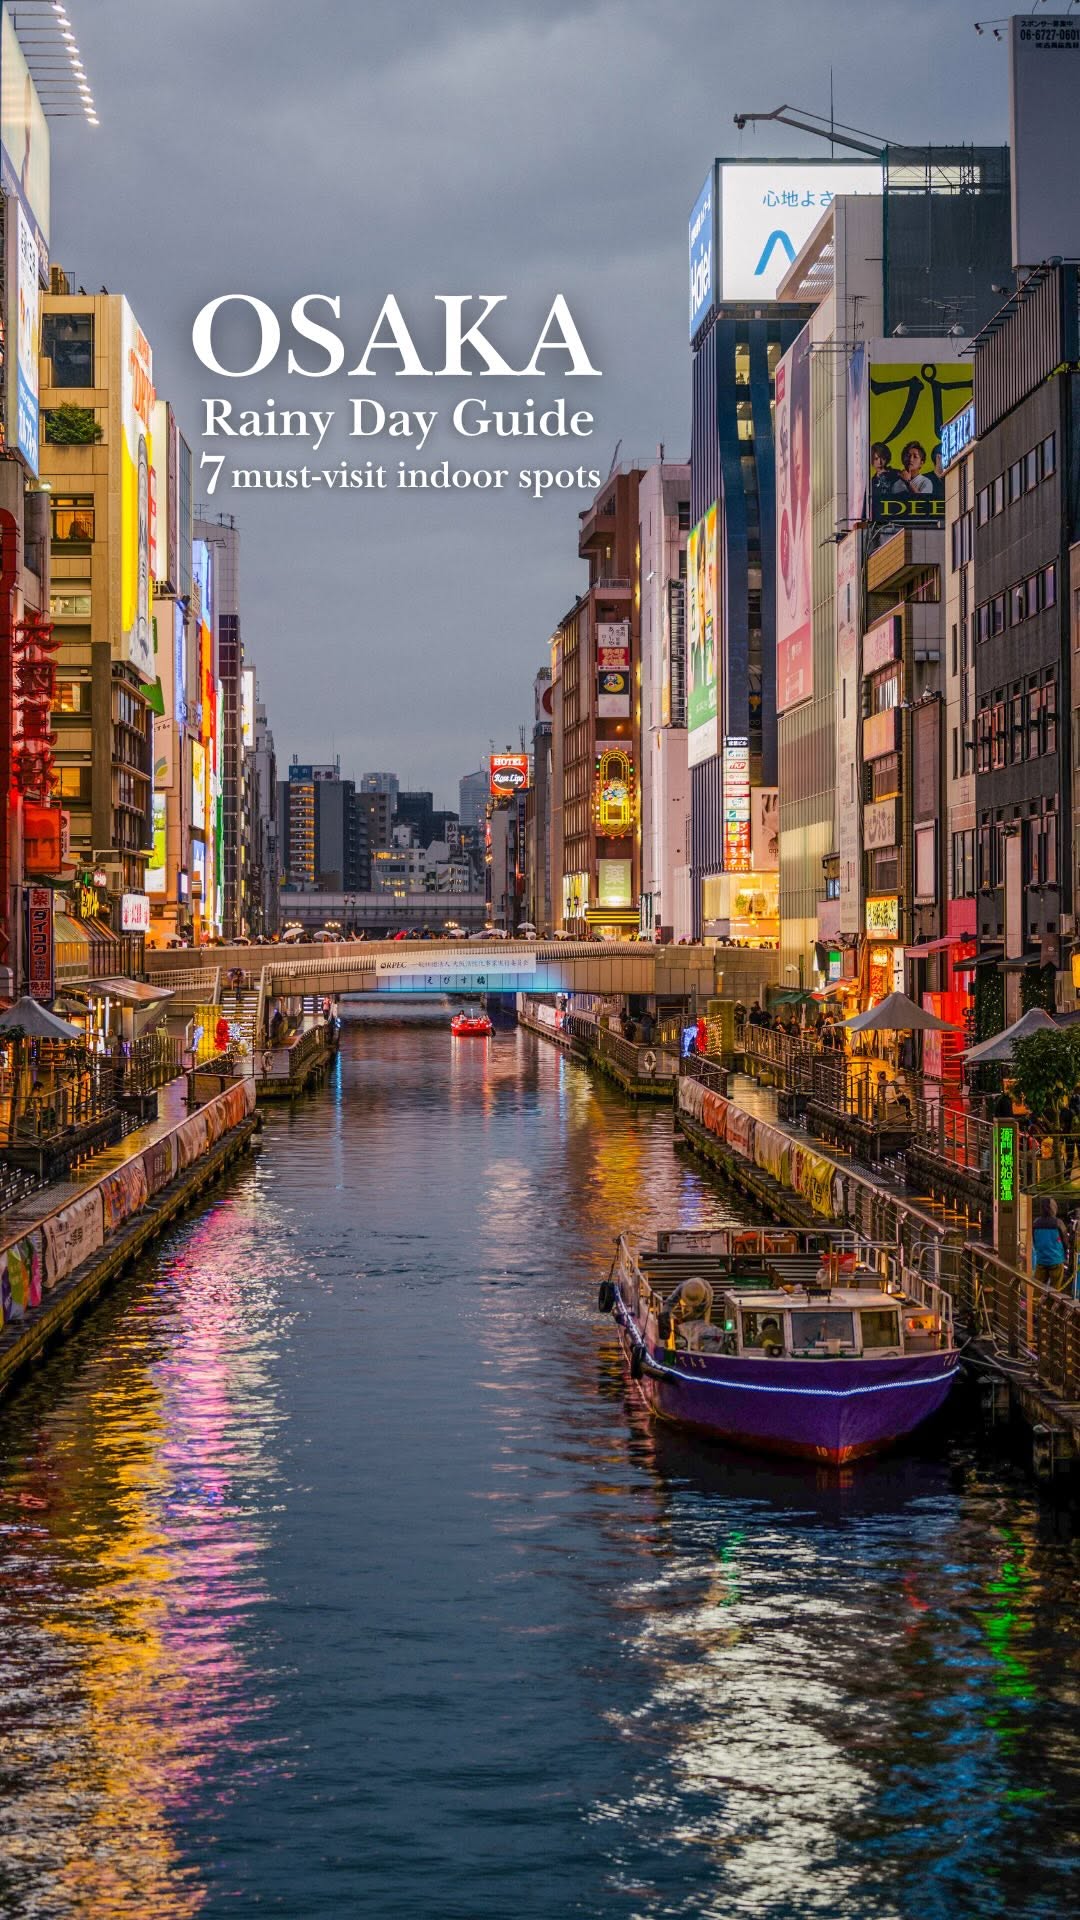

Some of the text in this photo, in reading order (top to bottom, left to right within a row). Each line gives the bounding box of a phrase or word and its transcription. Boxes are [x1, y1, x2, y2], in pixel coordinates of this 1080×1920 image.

[1020, 29, 1080, 40] 06-6727-0601
[494, 758, 524, 766] HOTEL
[494, 773, 524, 785] Rose Lips
[32, 888, 49, 906] 薬
[33, 910, 48, 956] ダイコク
